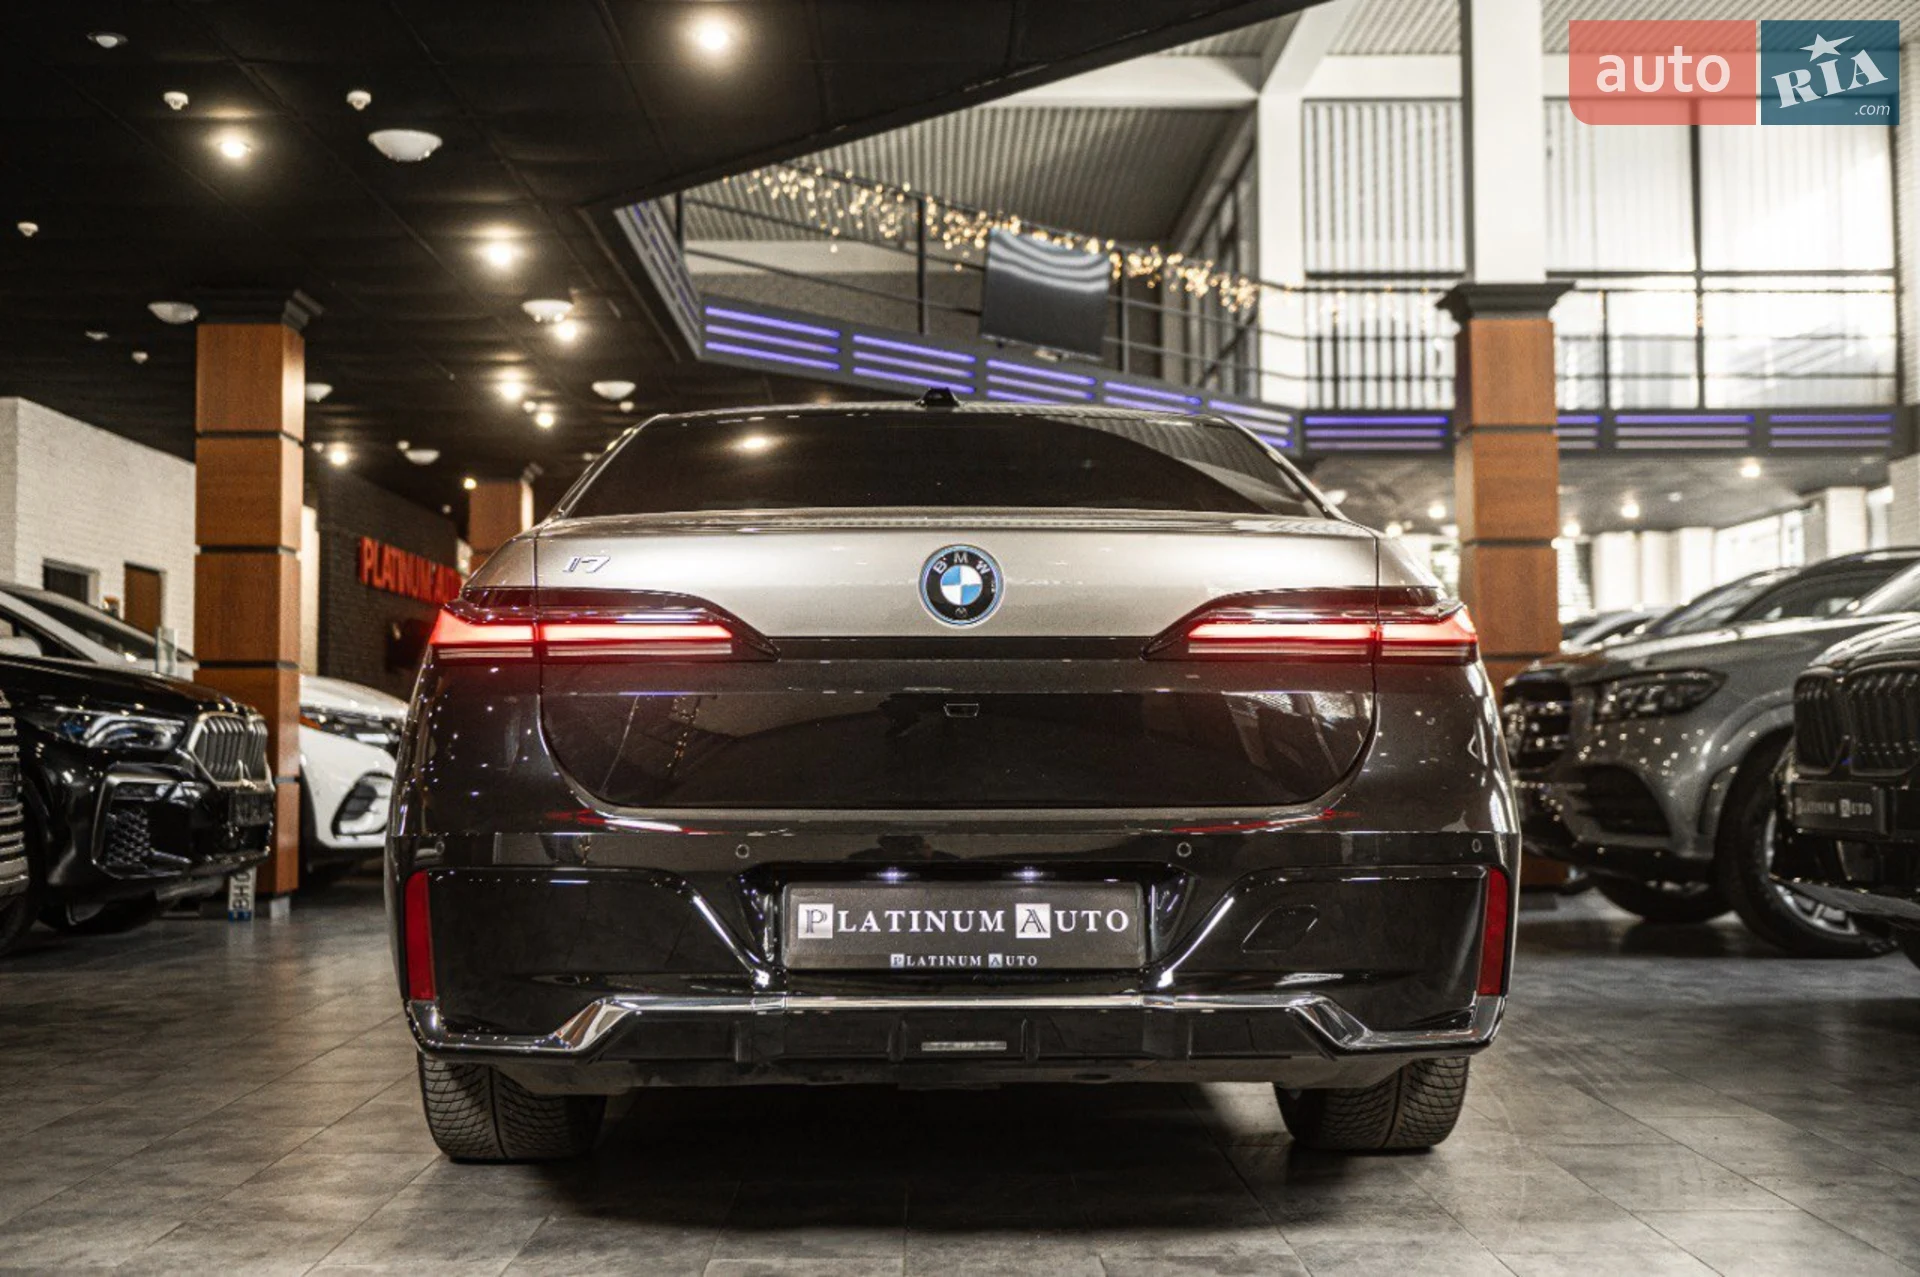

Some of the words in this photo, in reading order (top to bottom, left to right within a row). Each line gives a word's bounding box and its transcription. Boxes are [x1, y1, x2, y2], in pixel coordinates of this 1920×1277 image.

[359, 536, 433, 602] PLATINUM
[933, 552, 990, 575] BMW
[798, 903, 1006, 939] PLATINUM
[1015, 903, 1129, 939] AUTO
[890, 953, 982, 968] PLATINUM
[988, 953, 1038, 968] AUTO
